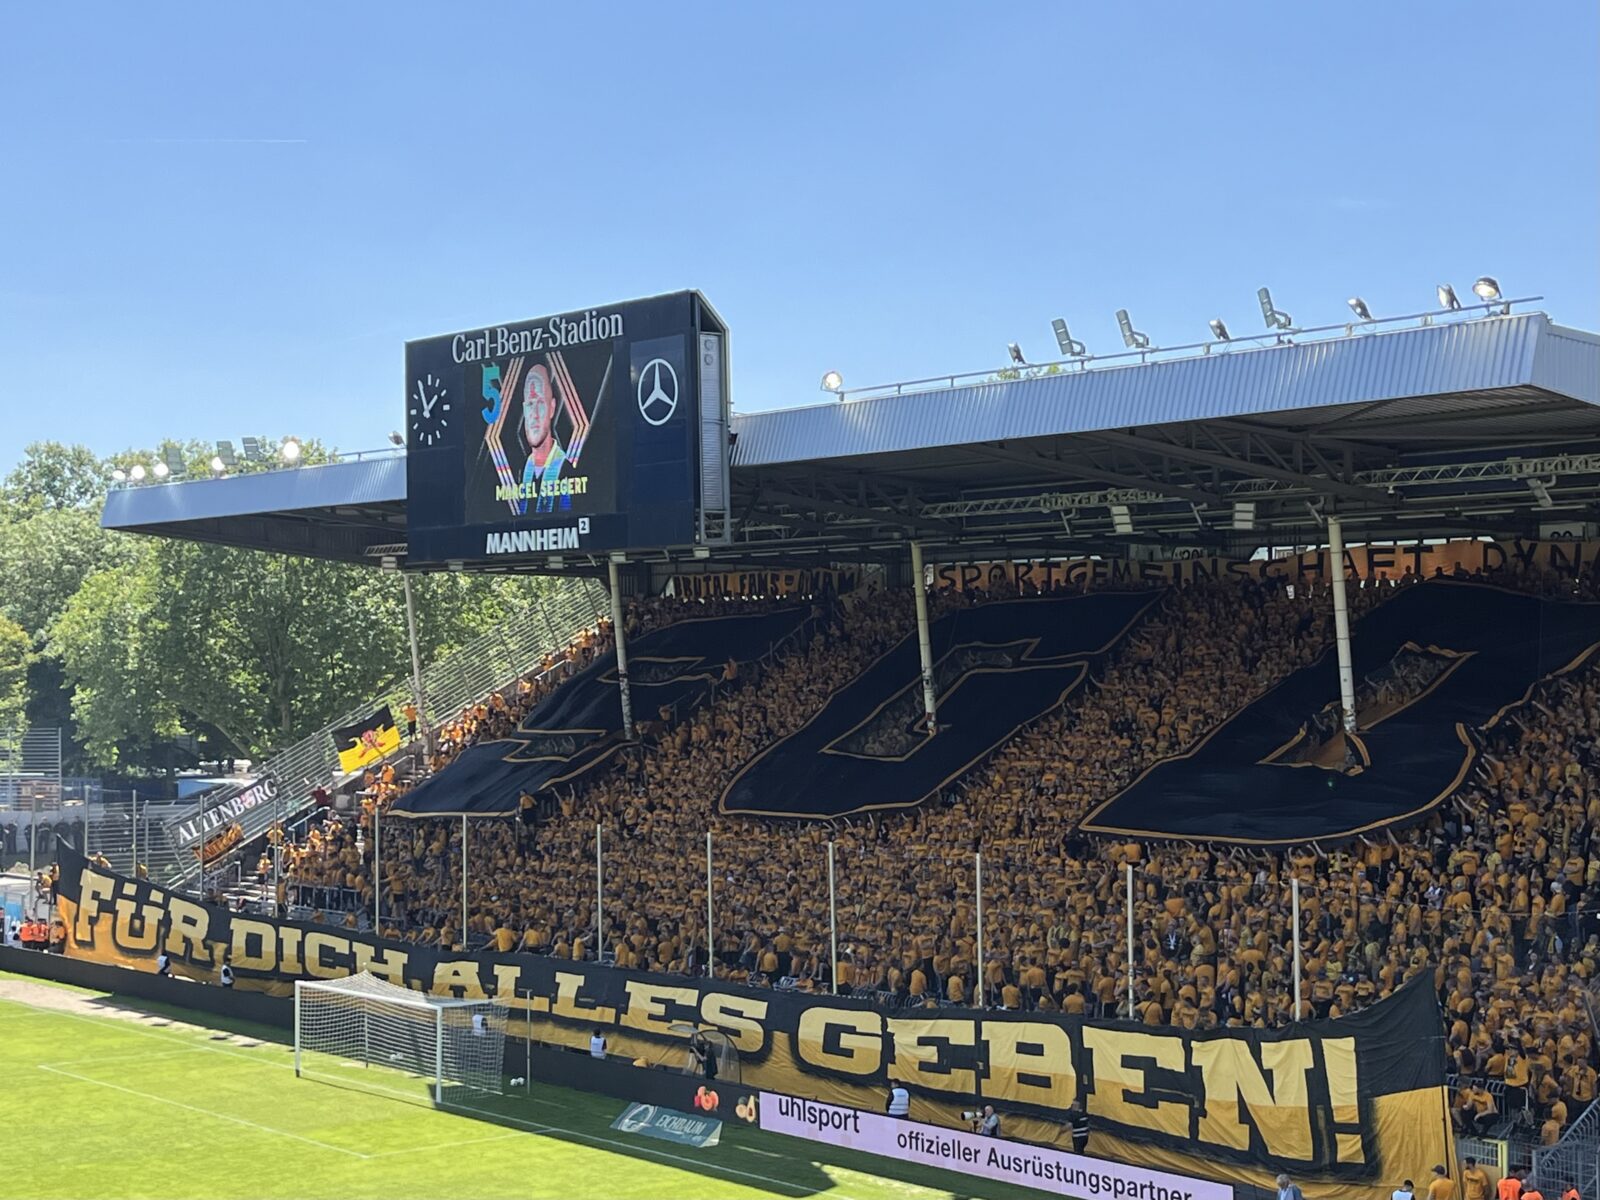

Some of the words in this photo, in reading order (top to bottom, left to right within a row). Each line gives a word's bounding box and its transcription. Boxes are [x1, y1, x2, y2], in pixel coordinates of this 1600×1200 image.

[452, 311, 624, 364] Carl-Benz-Stadion
[481, 363, 503, 426] 5
[495, 481, 538, 502] MARCEL
[540, 476, 588, 498] SEEGERT
[486, 527, 579, 555] MANNHEIM
[75, 868, 214, 961] FÜR
[229, 916, 408, 987] DICH
[428, 960, 768, 1053] ALLES
[798, 1006, 1366, 1164] GEBEN!
[655, 1114, 708, 1135] EICHBAUM
[778, 1096, 861, 1136] uhlsport
[897, 1131, 981, 1164] offizieller
[986, 1147, 1192, 1200] Ausrüstungspartner
